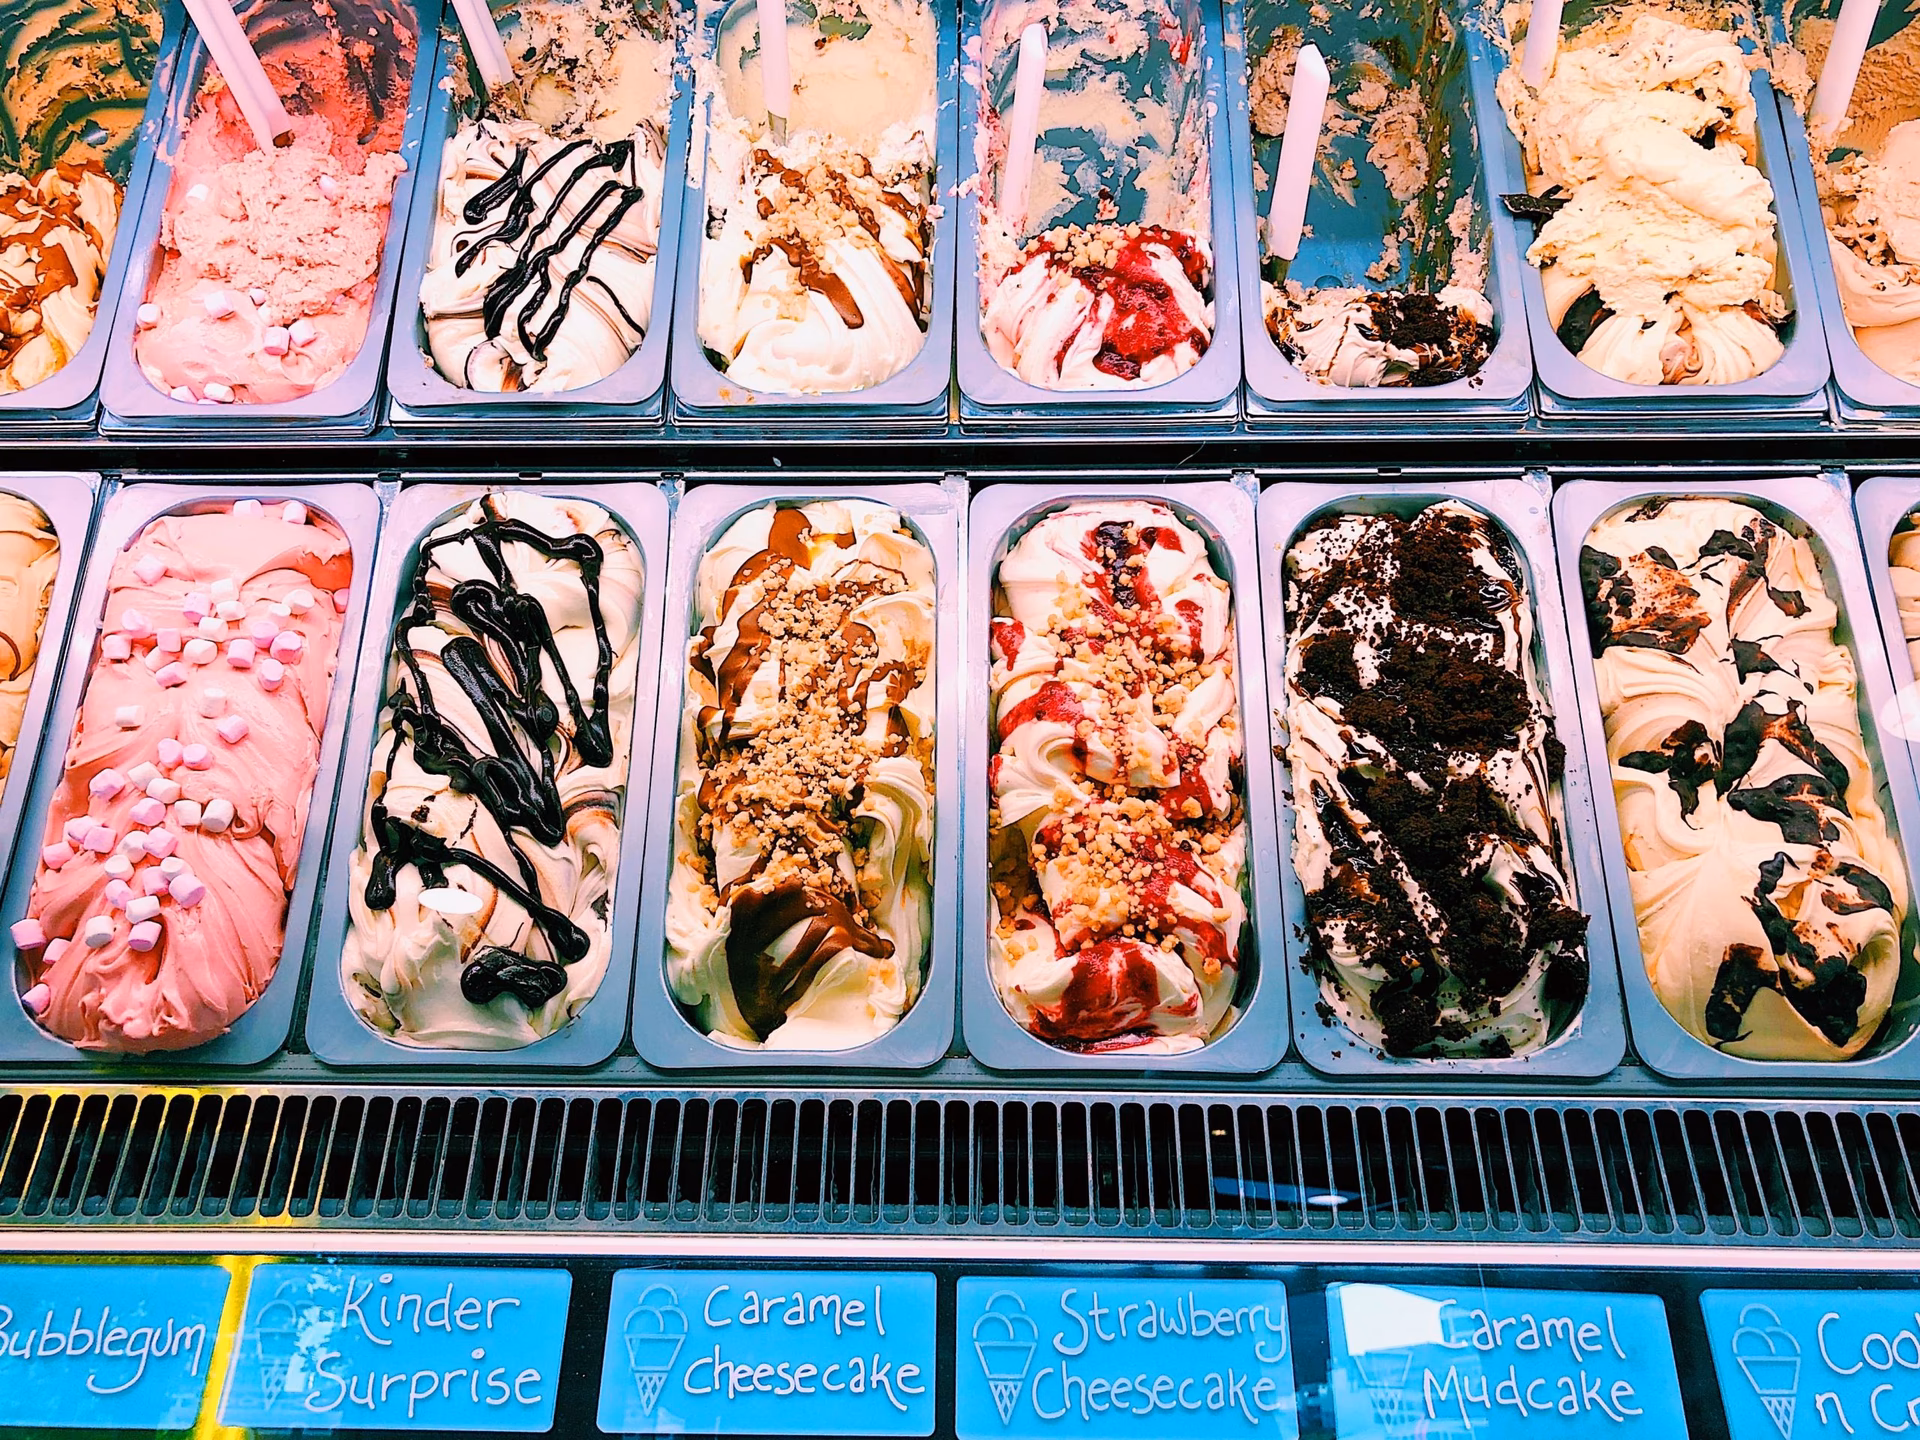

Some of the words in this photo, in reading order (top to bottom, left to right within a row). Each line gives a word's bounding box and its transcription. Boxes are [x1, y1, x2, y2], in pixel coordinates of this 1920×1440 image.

[341, 1273, 520, 1346] Kinder
[703, 1284, 886, 1336] Caramel
[1052, 1288, 1288, 1363] Strawberry
[1817, 1311, 1920, 1375] Coo
[304, 1348, 543, 1419] Surprise
[1032, 1360, 1282, 1425] Cheesecake
[1423, 1365, 1643, 1428] Mudcake
